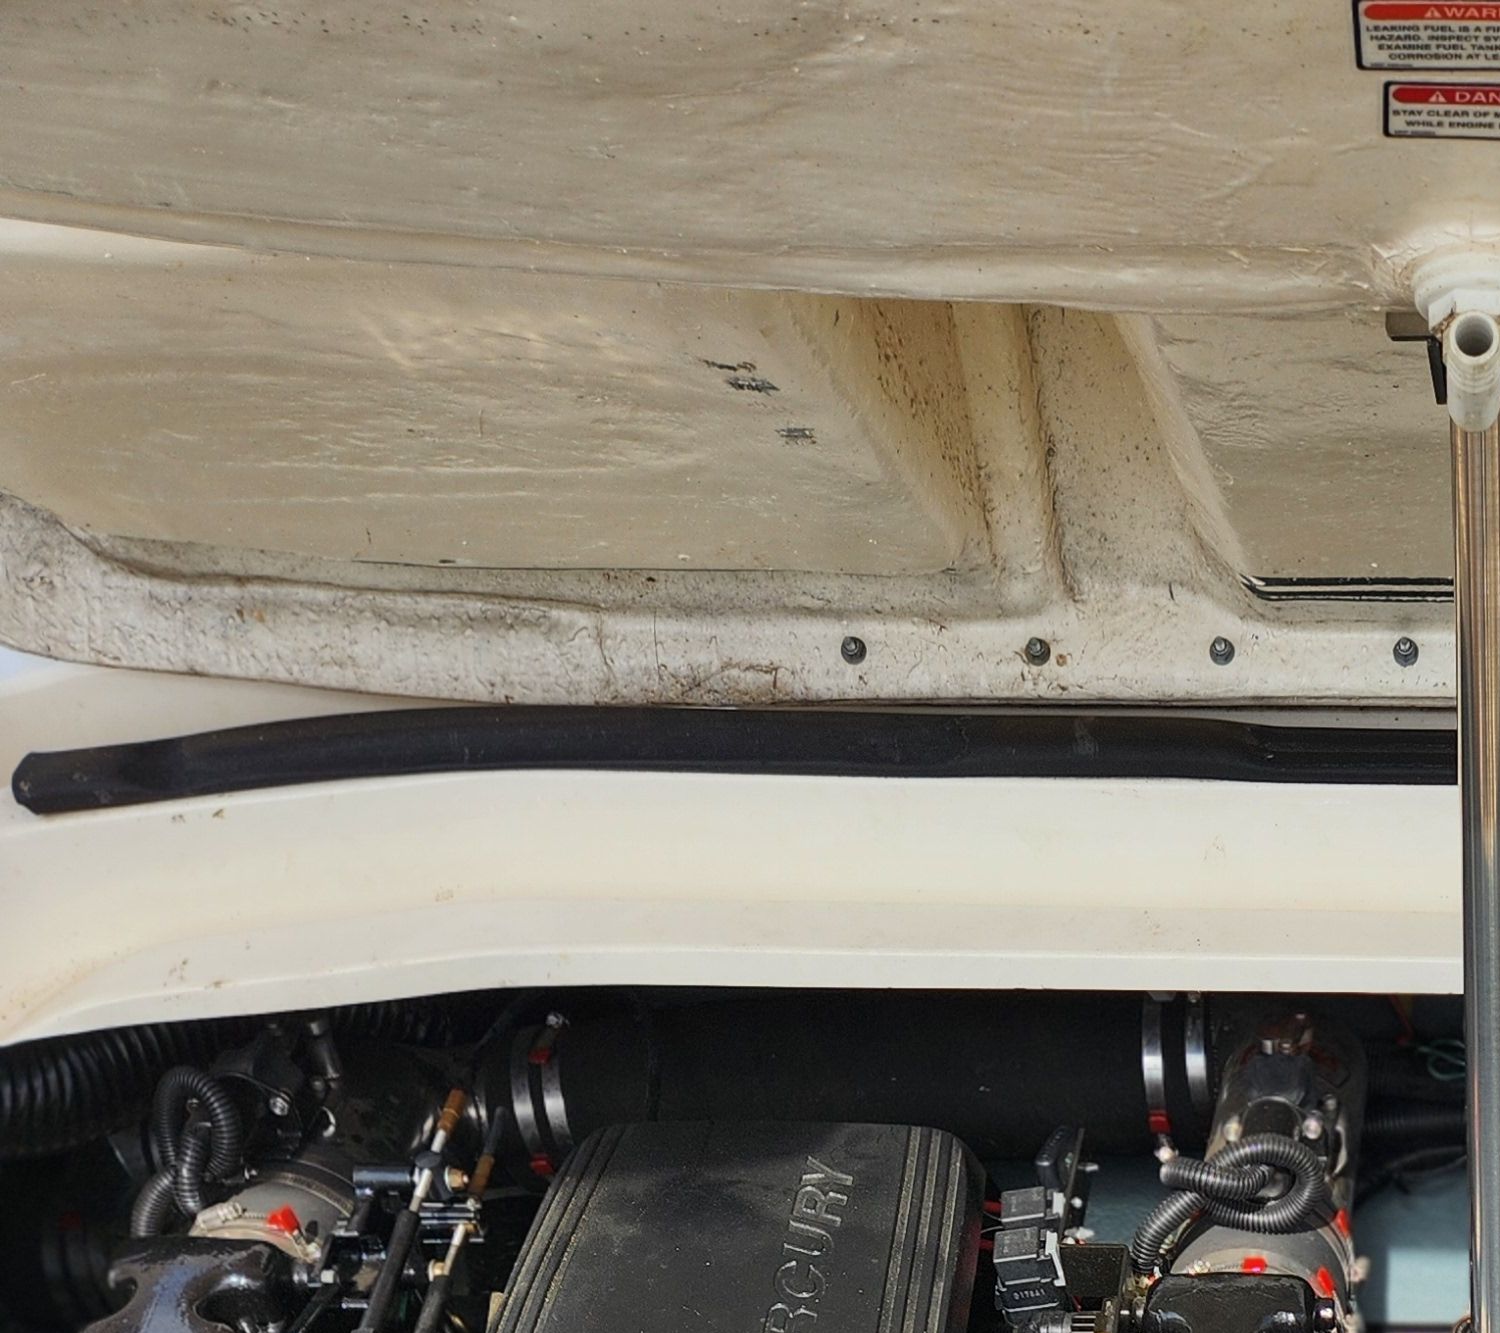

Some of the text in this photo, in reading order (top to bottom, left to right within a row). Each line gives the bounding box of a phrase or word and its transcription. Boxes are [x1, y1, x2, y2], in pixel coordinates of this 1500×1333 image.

[1389, 52, 1462, 60] CORROSION
[1392, 110, 1423, 118] STAY
[1426, 110, 1470, 118] CLEAR
[1474, 110, 1489, 118] OF
[1406, 120, 1444, 128] WHILE
[1449, 121, 1494, 129] ENGINE
